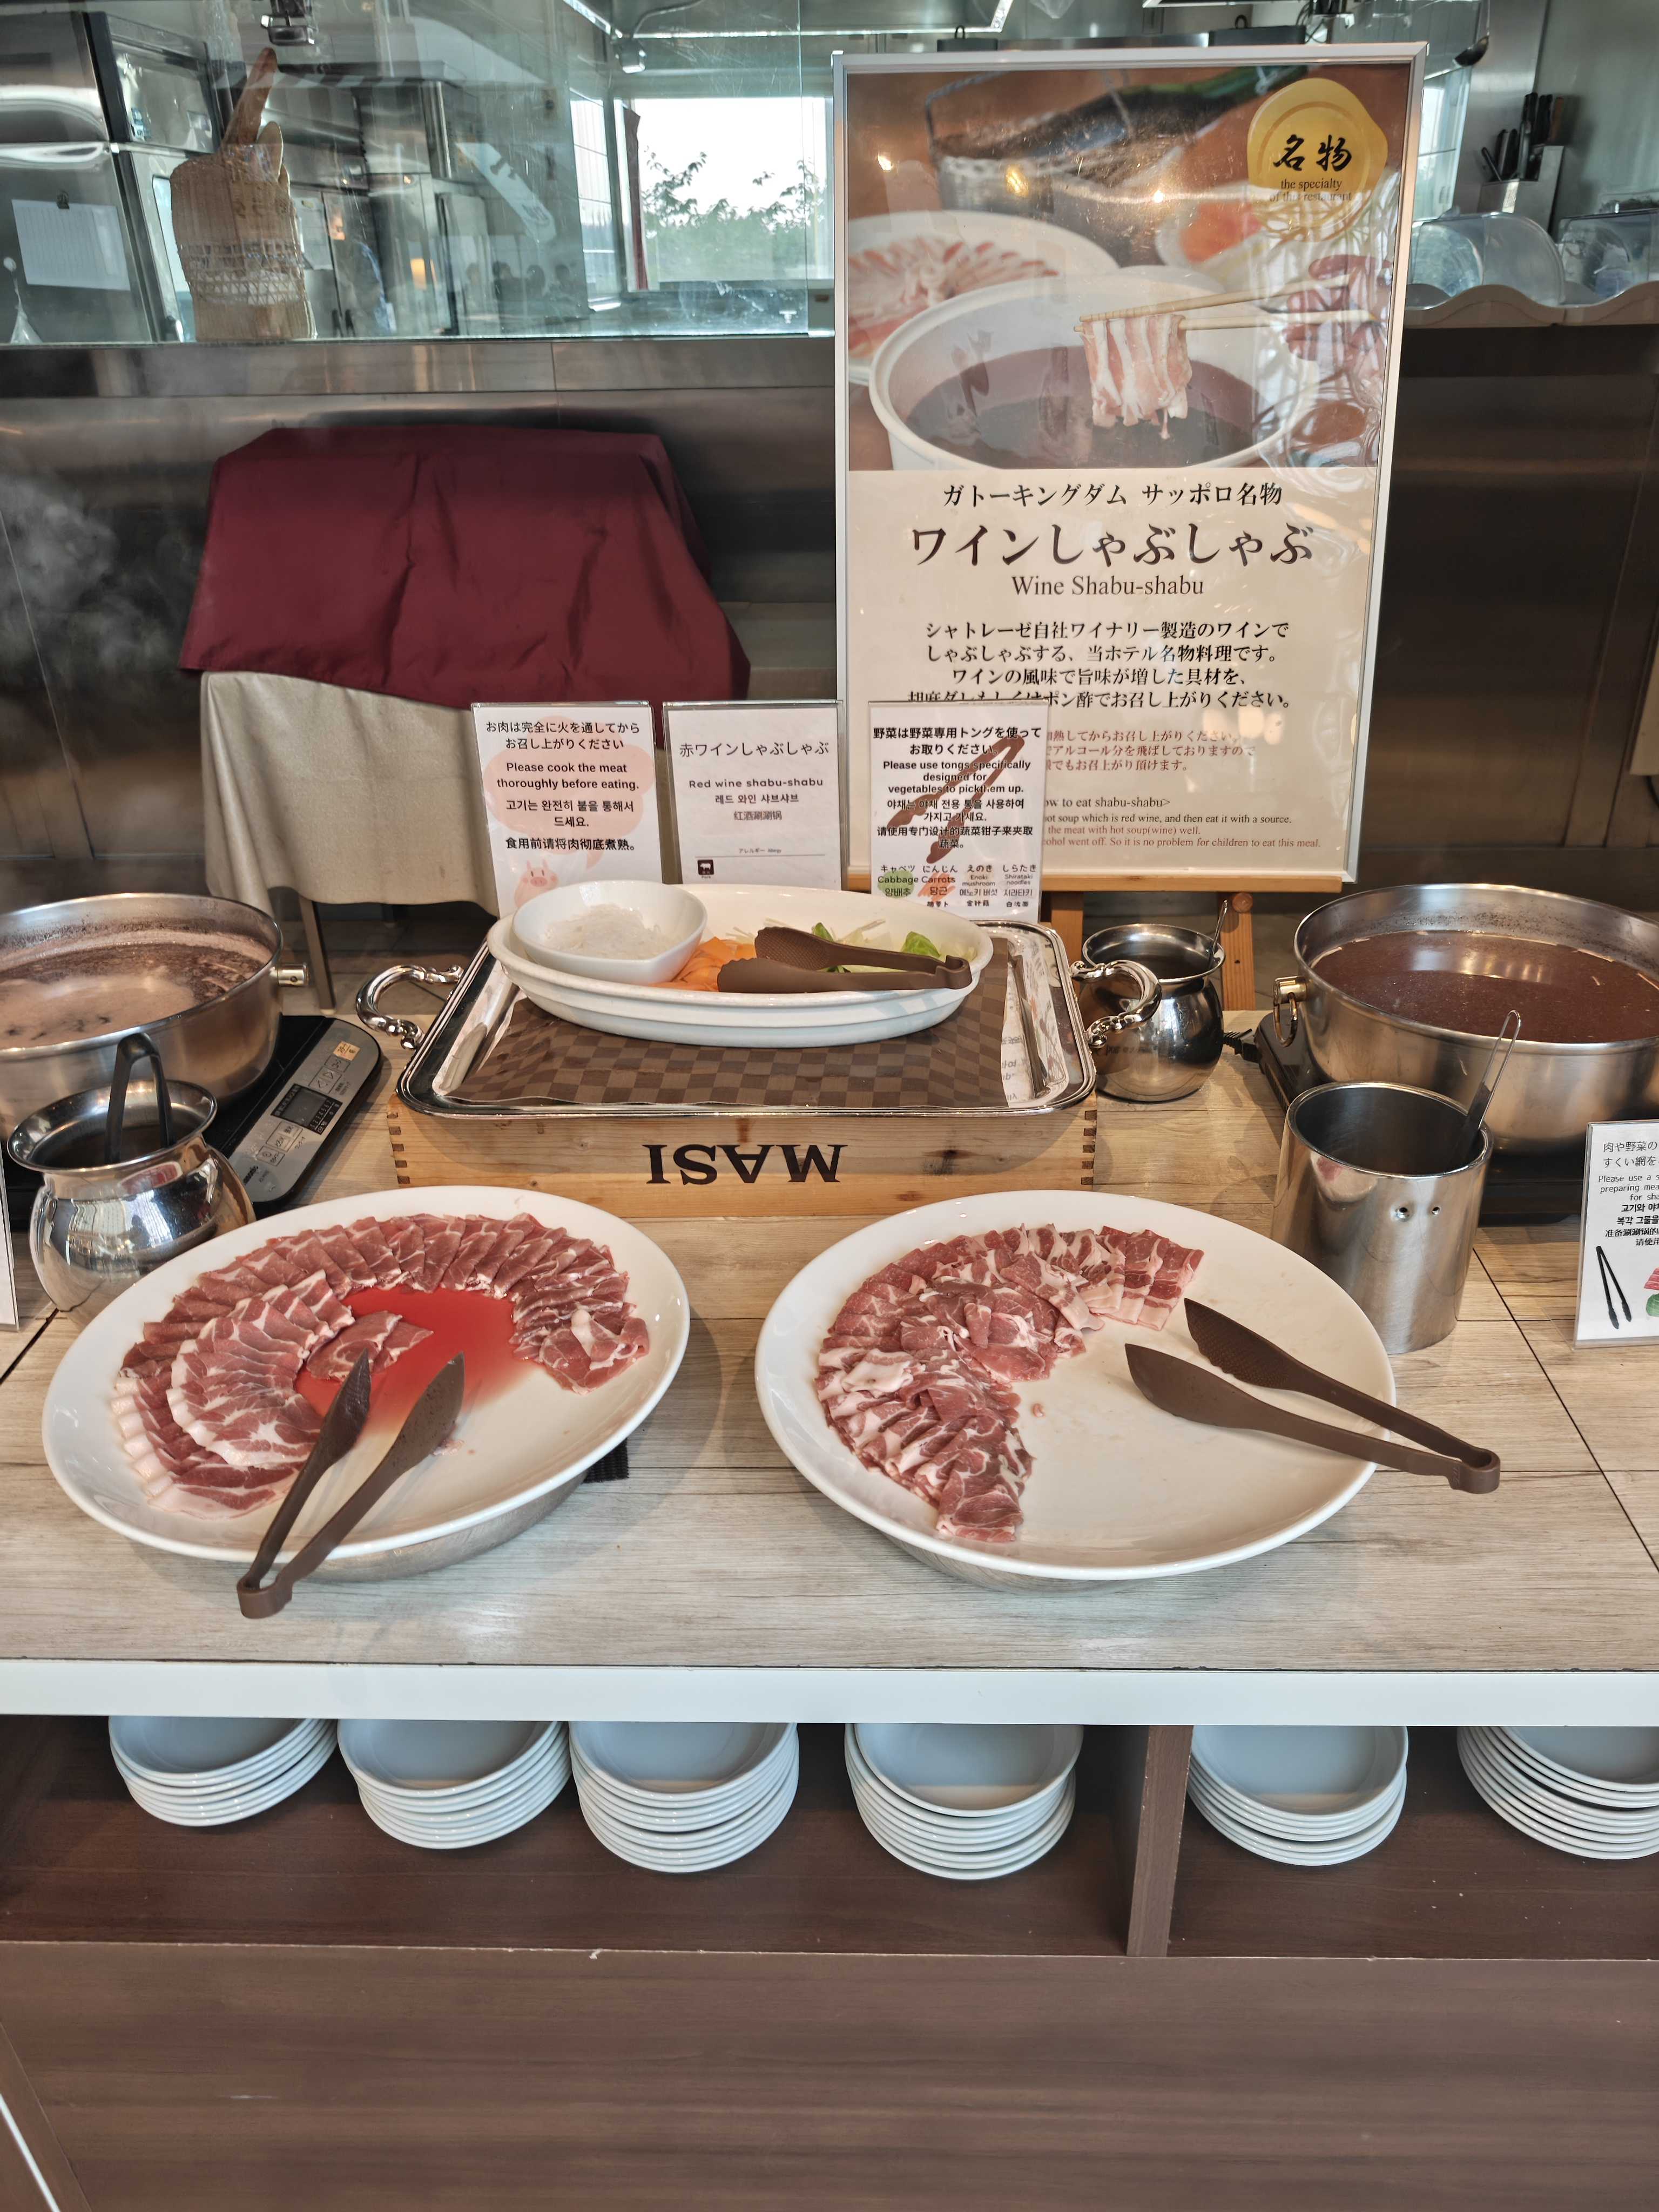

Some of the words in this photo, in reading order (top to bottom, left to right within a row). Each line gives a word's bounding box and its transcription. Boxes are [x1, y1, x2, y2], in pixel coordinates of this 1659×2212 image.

[1273, 134, 1352, 172] 名物
[1281, 179, 1296, 188] the
[1298, 178, 1343, 191] specialty
[944, 484, 1127, 507] ガトーキングダム
[1142, 482, 1283, 506] サッポロ名物
[912, 522, 1314, 567] ワインしゃぶしゃぶ
[1011, 576, 1064, 595] Wine
[1072, 575, 1204, 595] Shabu-shabu
[926, 622, 1289, 639] シャトレーゼ自社ワイナリー製造のワインで
[928, 645, 1275, 663] しゃぶしゃぶする、当ホテル名物料理です。
[953, 668, 1245, 685] ワインの風味で旨味が増した具材を、
[485, 721, 640, 733] お肉は完全に火を通してから
[873, 727, 1042, 739] 野菜は野菜専用トングを使って
[505, 738, 624, 750] お召し上がりください
[679, 741, 830, 757] 赤ワインしゃぶしゃぶ
[910, 744, 998, 756] お取りください。
[506, 763, 544, 772] Please
[548, 763, 575, 772] cook
[578, 763, 596, 772] the
[599, 764, 628, 773] meat
[883, 761, 917, 770] Please
[941, 761, 970, 771] tongs
[973, 760, 1031, 771] specifically
[689, 780, 711, 788] Red
[715, 779, 742, 788] wine
[746, 778, 823, 787] shabu-shabu
[923, 773, 970, 782] designed
[973, 773, 987, 781] for
[497, 778, 558, 790] thoroughly
[562, 779, 598, 788] before
[601, 780, 639, 791] eating.
[888, 785, 943, 795] vegetables
[946, 785, 956, 793] to
[1008, 786, 1024, 795] up.
[715, 794, 733, 804] 레드
[738, 794, 756, 804] 와인
[761, 793, 799, 803] 샤브샤브
[887, 799, 916, 809] 야채는
[919, 799, 938, 809] 야채
[941, 799, 960, 809] 전용
[986, 799, 1024, 809] 사용하여
[1045, 799, 1058, 807] ow
[1062, 798, 1073, 807] to
[1076, 798, 1091, 807] eat
[1095, 797, 1170, 807] shabu-shabu>
[505, 799, 538, 811] 고기는
[542, 799, 573, 811] 완전히
[577, 800, 599, 812] 불을
[602, 800, 634, 812] 통해서
[554, 816, 590, 828] 드세요.
[924, 812, 952, 822] 가지고
[955, 812, 987, 822] 가세요.
[1058, 815, 1079, 824] soup
[1082, 814, 1108, 822] which
[1111, 814, 1118, 822] is
[1121, 814, 1135, 822] red
[1138, 814, 1162, 824] wine,
[1165, 814, 1181, 822] and
[1184, 814, 1203, 823] then
[1221, 814, 1227, 823] it
[1231, 814, 1250, 823] with
[1048, 825, 1062, 834] the
[1088, 826, 1108, 834] with
[1110, 826, 1124, 834] hot
[1127, 826, 1177, 837] soup(wine)
[1179, 826, 1201, 835] well.
[505, 837, 635, 851] 食用前请将肉彻底煮熟。
[1110, 838, 1122, 846] So
[1125, 838, 1131, 846] it
[1134, 838, 1141, 846] is
[1157, 838, 1193, 848] problem
[1197, 838, 1210, 847] for
[1212, 838, 1249, 847] children
[1251, 839, 1260, 847] to
[1263, 839, 1275, 847] eat
[1278, 838, 1294, 847] this
[1297, 839, 1321, 848] meal.
[881, 865, 915, 873] キャベツ
[923, 865, 958, 873] にんじん
[967, 865, 993, 873] えのき
[1003, 865, 1036, 873] しらたき
[878, 876, 919, 885] Cabbage
[1603, 1141, 1657, 1152] 肉や野菜の
[642, 1144, 848, 1185] MASI
[1600, 1184, 1640, 1194] preparing
[1621, 1203, 1645, 1212] 고기와
[1605, 1227, 1659, 1237] 准备涮涮锅的
